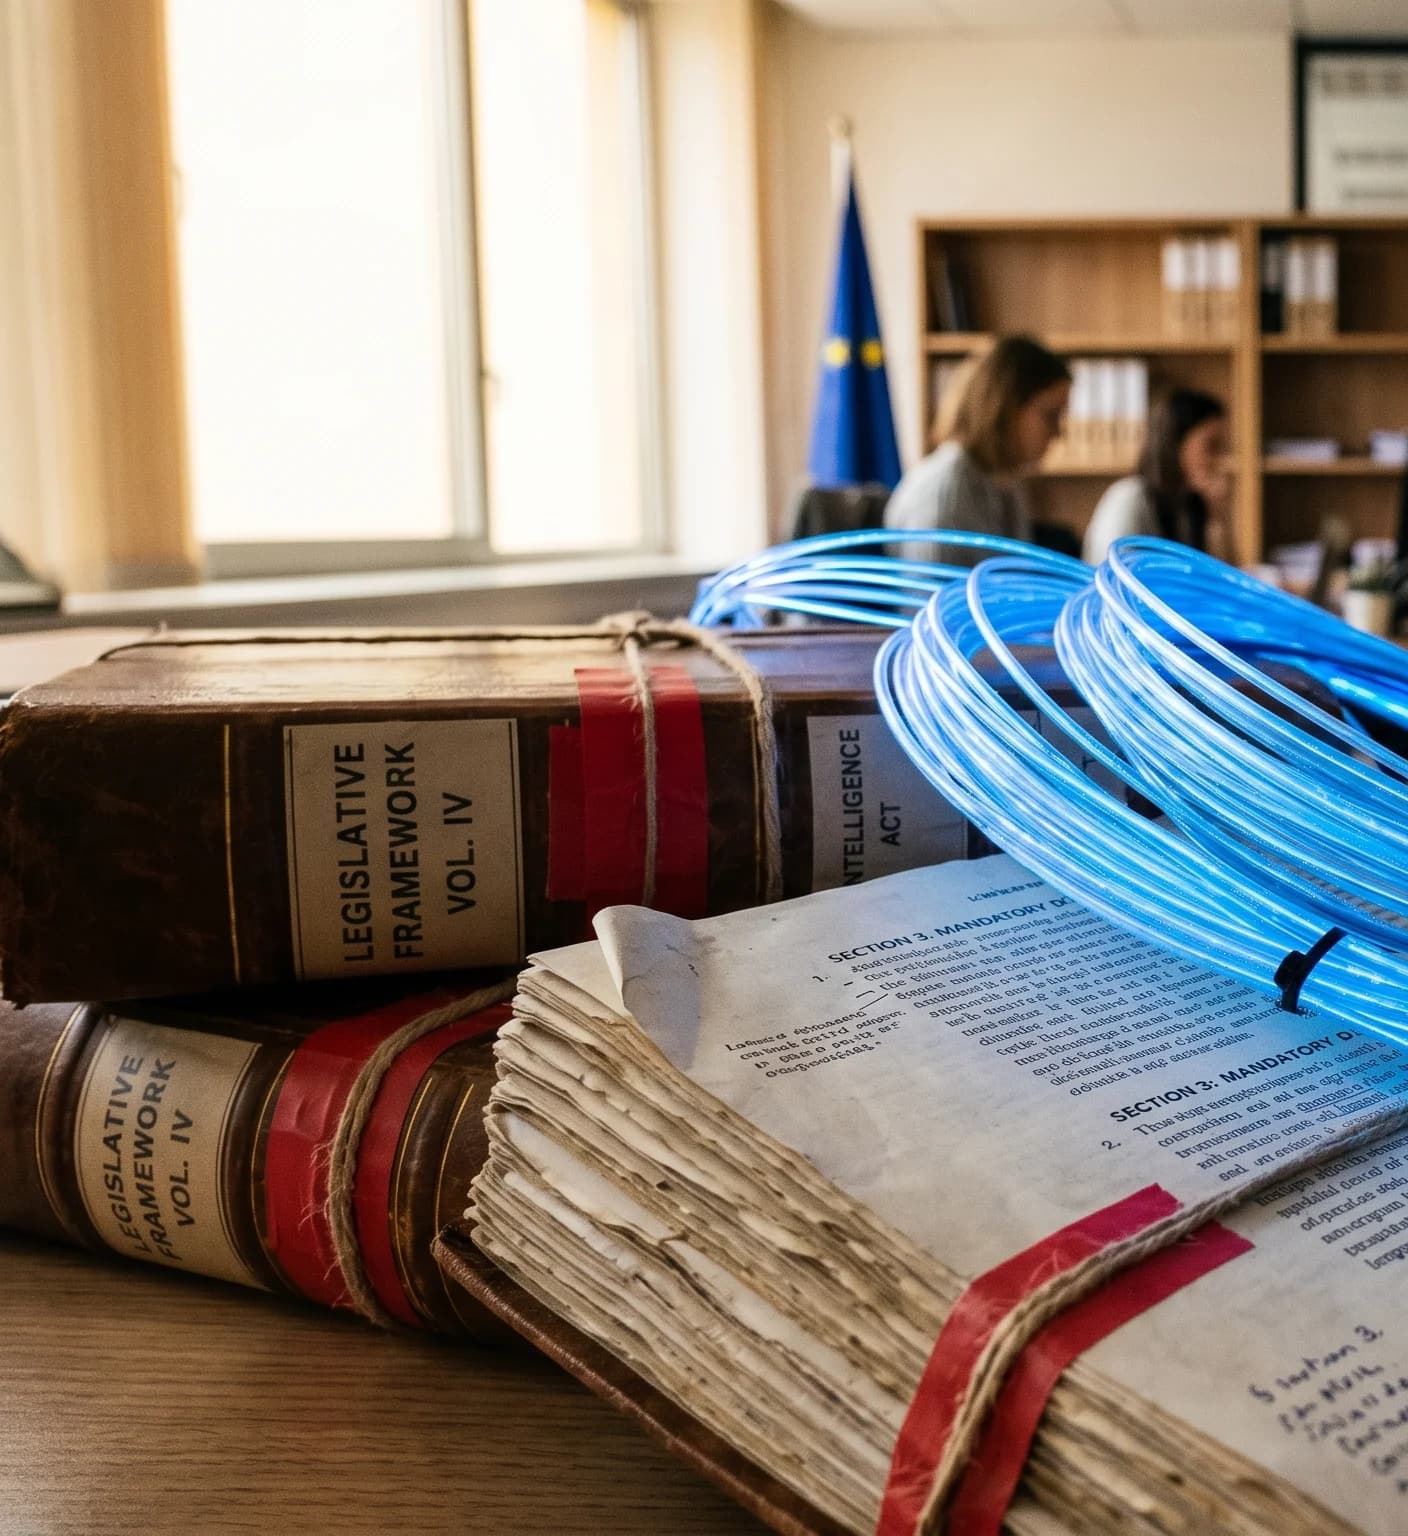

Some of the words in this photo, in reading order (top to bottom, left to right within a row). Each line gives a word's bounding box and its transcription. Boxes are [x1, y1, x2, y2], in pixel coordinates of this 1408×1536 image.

[442, 792, 473, 825] IV
[839, 729, 864, 886] NTELLIGENCE
[880, 801, 901, 846] ACT
[334, 743, 375, 962] LEGISLATIVE
[384, 742, 424, 959] FRAMEWORK
[446, 839, 477, 916] VOL.
[828, 935, 913, 964] SECTION
[913, 932, 934, 947] 3.
[934, 903, 1047, 937] MANDATORY
[1109, 1085, 1197, 1123] SECTION
[1195, 1077, 1219, 1092] 3:
[1219, 1036, 1334, 1083] MANDATORY
[102, 1055, 153, 1254] LEGISLATIVE
[133, 1058, 184, 1261] FRAMEWORK
[170, 1109, 194, 1145] IV
[1101, 1139, 1122, 1151] 2.
[170, 1160, 197, 1228] VOL.
